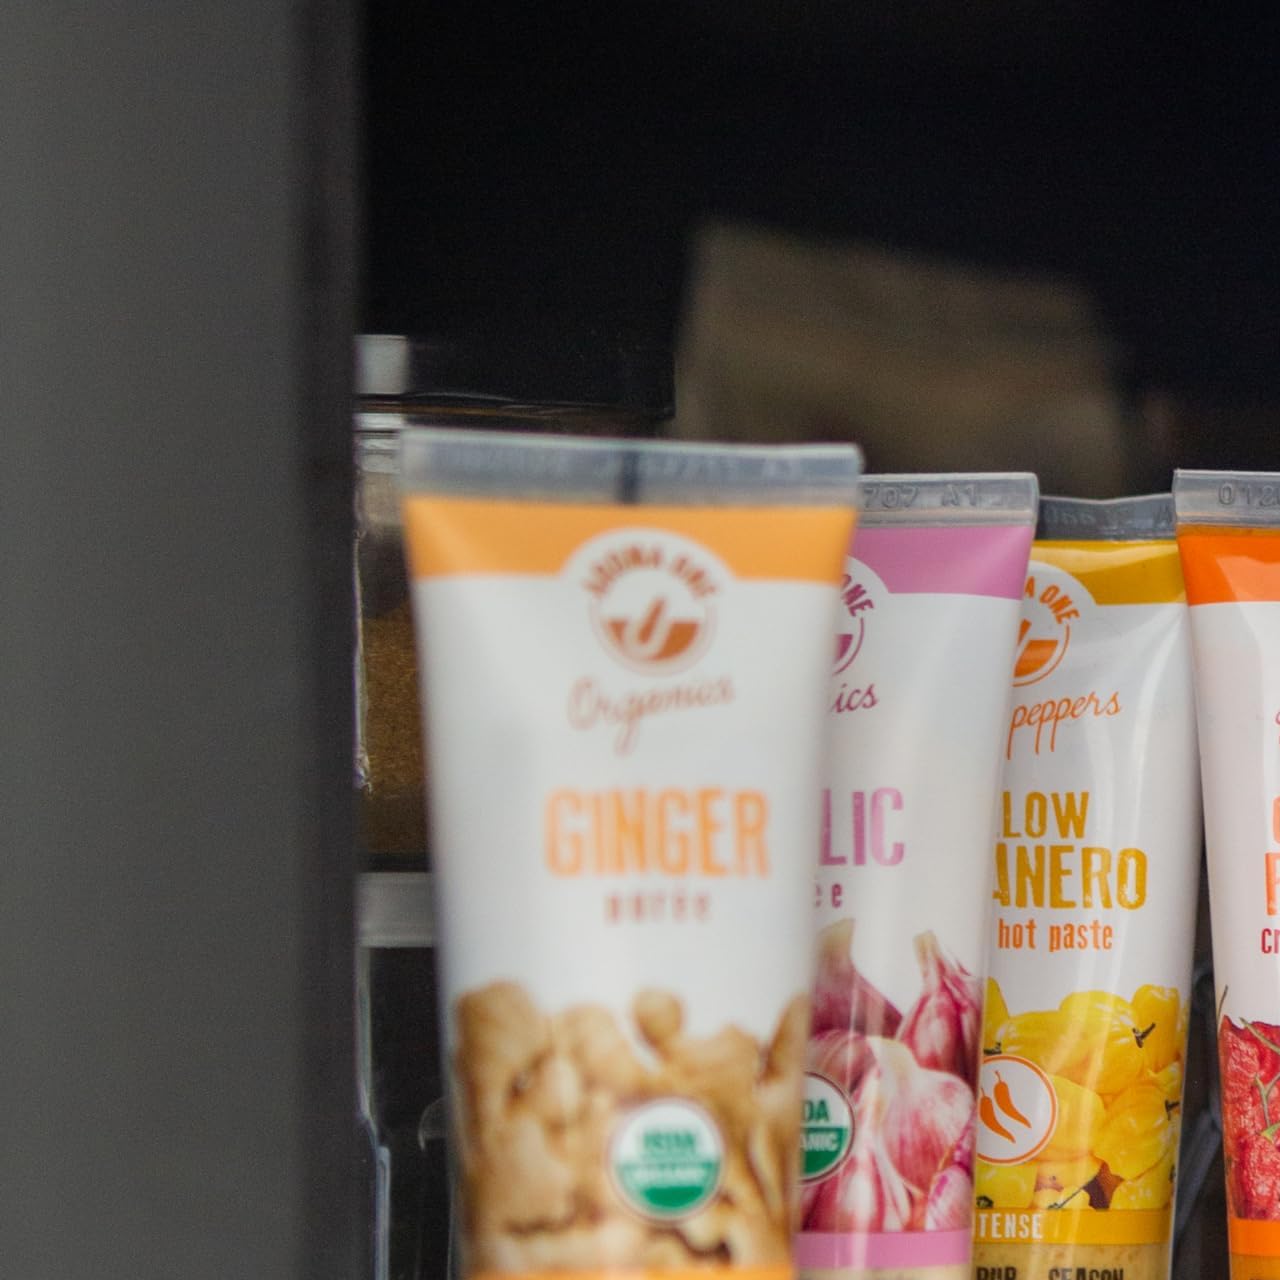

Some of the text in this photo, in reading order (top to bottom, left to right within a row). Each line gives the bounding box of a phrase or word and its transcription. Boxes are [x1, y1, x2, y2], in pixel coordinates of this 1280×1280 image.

[1039, 584, 1080, 624] ONE
[1007, 691, 1122, 761] peppers
[544, 786, 771, 879] GINGER
[819, 787, 905, 866] LIC
[1002, 790, 1090, 839] LOW
[992, 842, 1148, 910] ANERO
[998, 918, 1113, 952] hot paste
[977, 1212, 1044, 1240] TENSE
